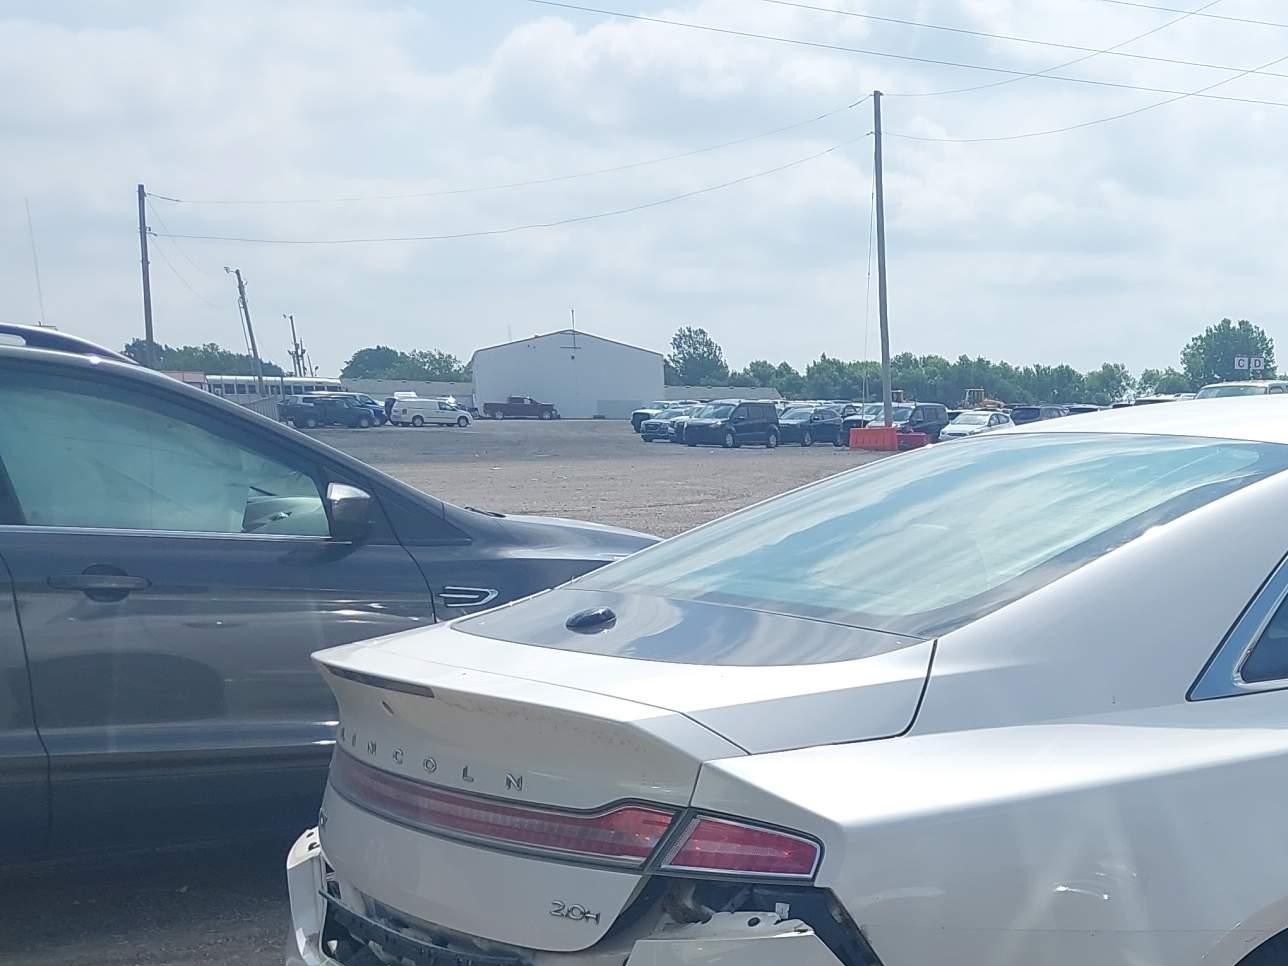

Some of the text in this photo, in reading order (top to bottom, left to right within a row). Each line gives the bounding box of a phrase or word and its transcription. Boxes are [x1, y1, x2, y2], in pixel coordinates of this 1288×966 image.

[1238, 359, 1245, 368] C
[1254, 359, 1261, 368] D
[341, 727, 523, 792] LINCOLN
